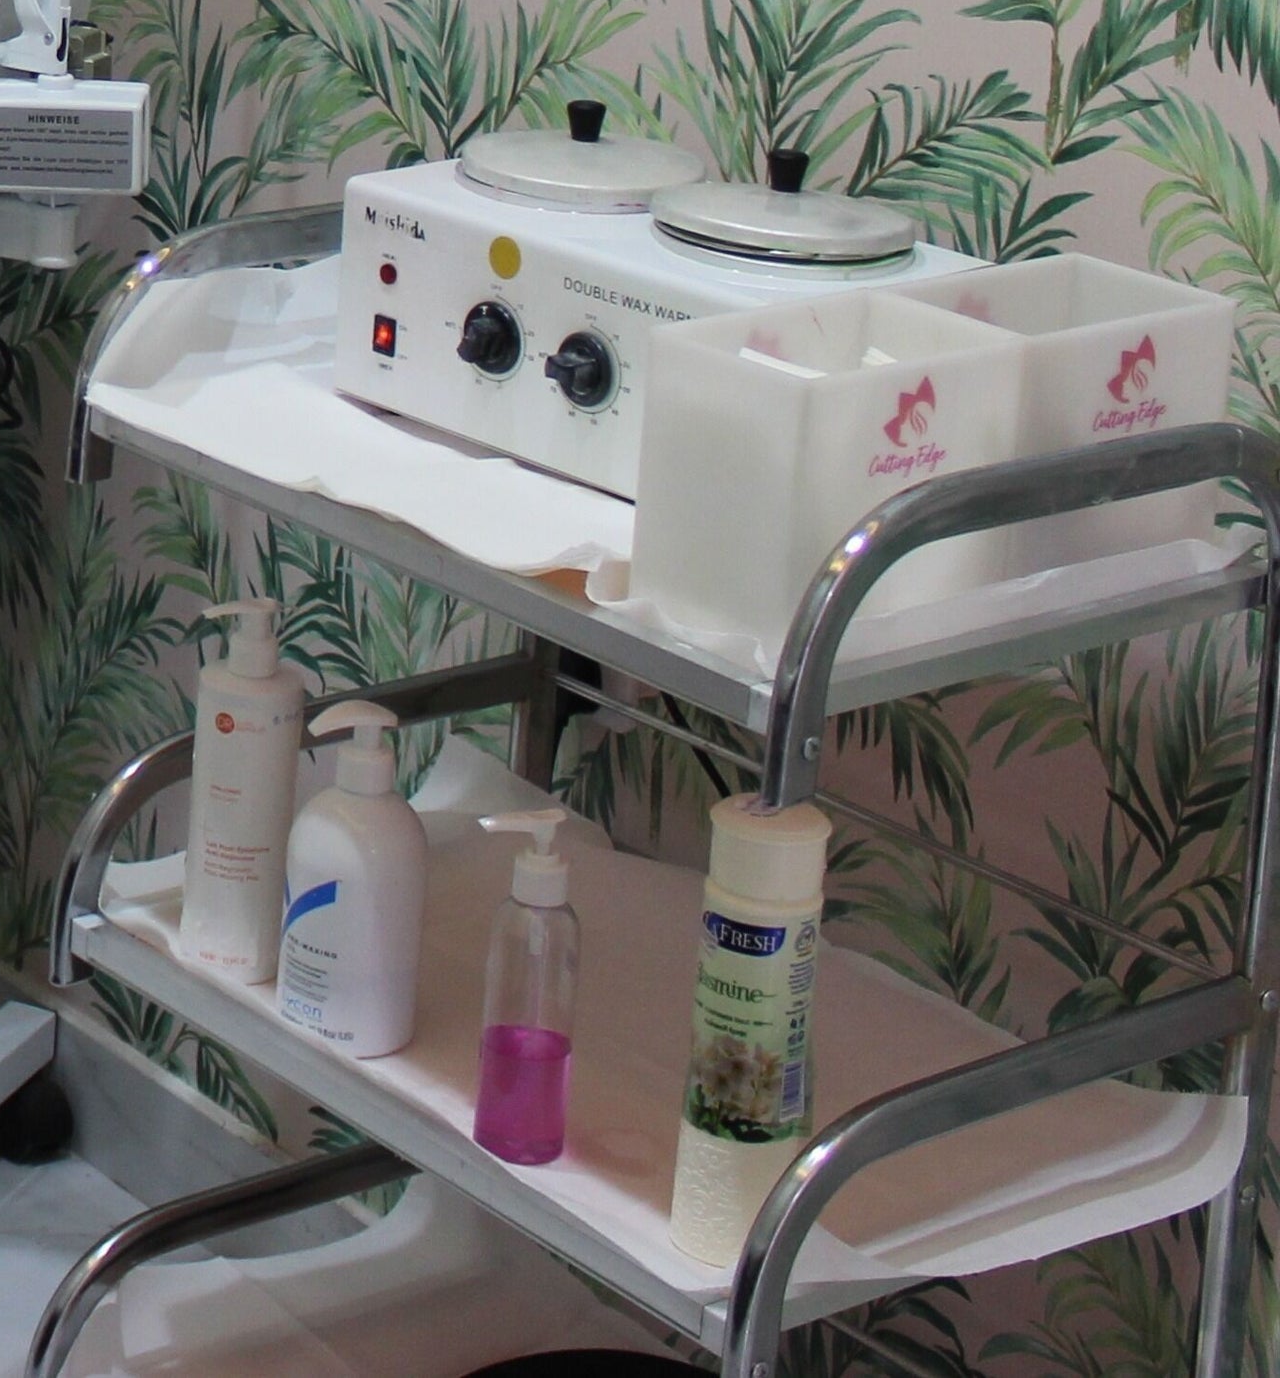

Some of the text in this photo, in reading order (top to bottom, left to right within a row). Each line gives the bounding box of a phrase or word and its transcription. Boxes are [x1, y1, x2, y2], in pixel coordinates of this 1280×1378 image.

[28, 114, 80, 125] HINWEISE
[564, 277, 618, 305] DOUBLE
[621, 294, 652, 315] WAX
[1092, 398, 1167, 433] Cutting Edge
[868, 442, 946, 478] Cutting Edge
[719, 923, 777, 952] FRESH
